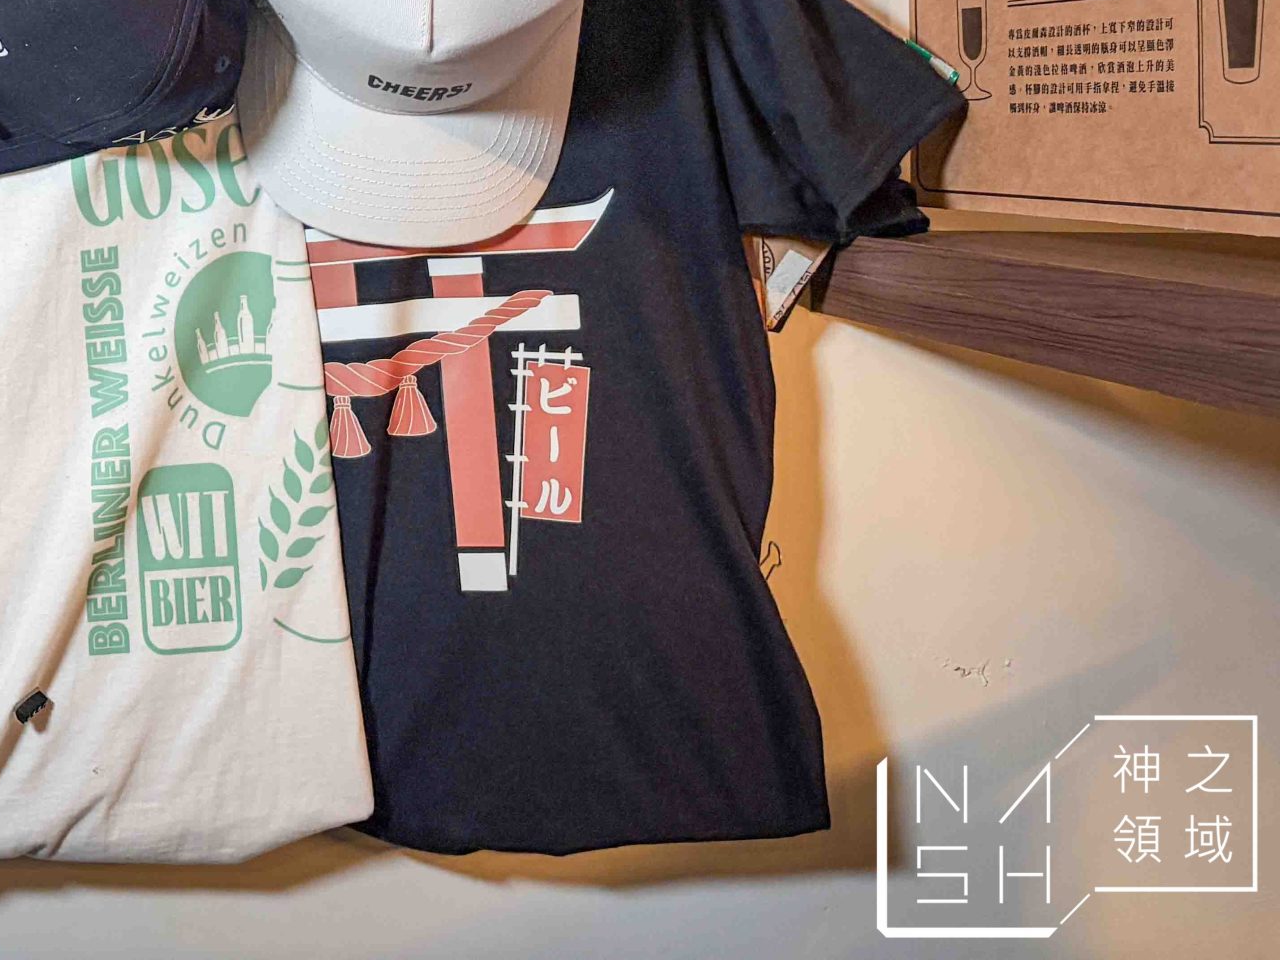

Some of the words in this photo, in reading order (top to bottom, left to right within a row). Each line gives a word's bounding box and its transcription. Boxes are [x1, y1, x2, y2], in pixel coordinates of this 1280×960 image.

[80, 244, 128, 418] WEISSE
[141, 222, 248, 451] Dunkelweizen
[534, 377, 578, 516] ビール
[86, 422, 132, 657] BERLINER
[140, 490, 230, 561] WIT
[149, 575, 234, 627] BIER
